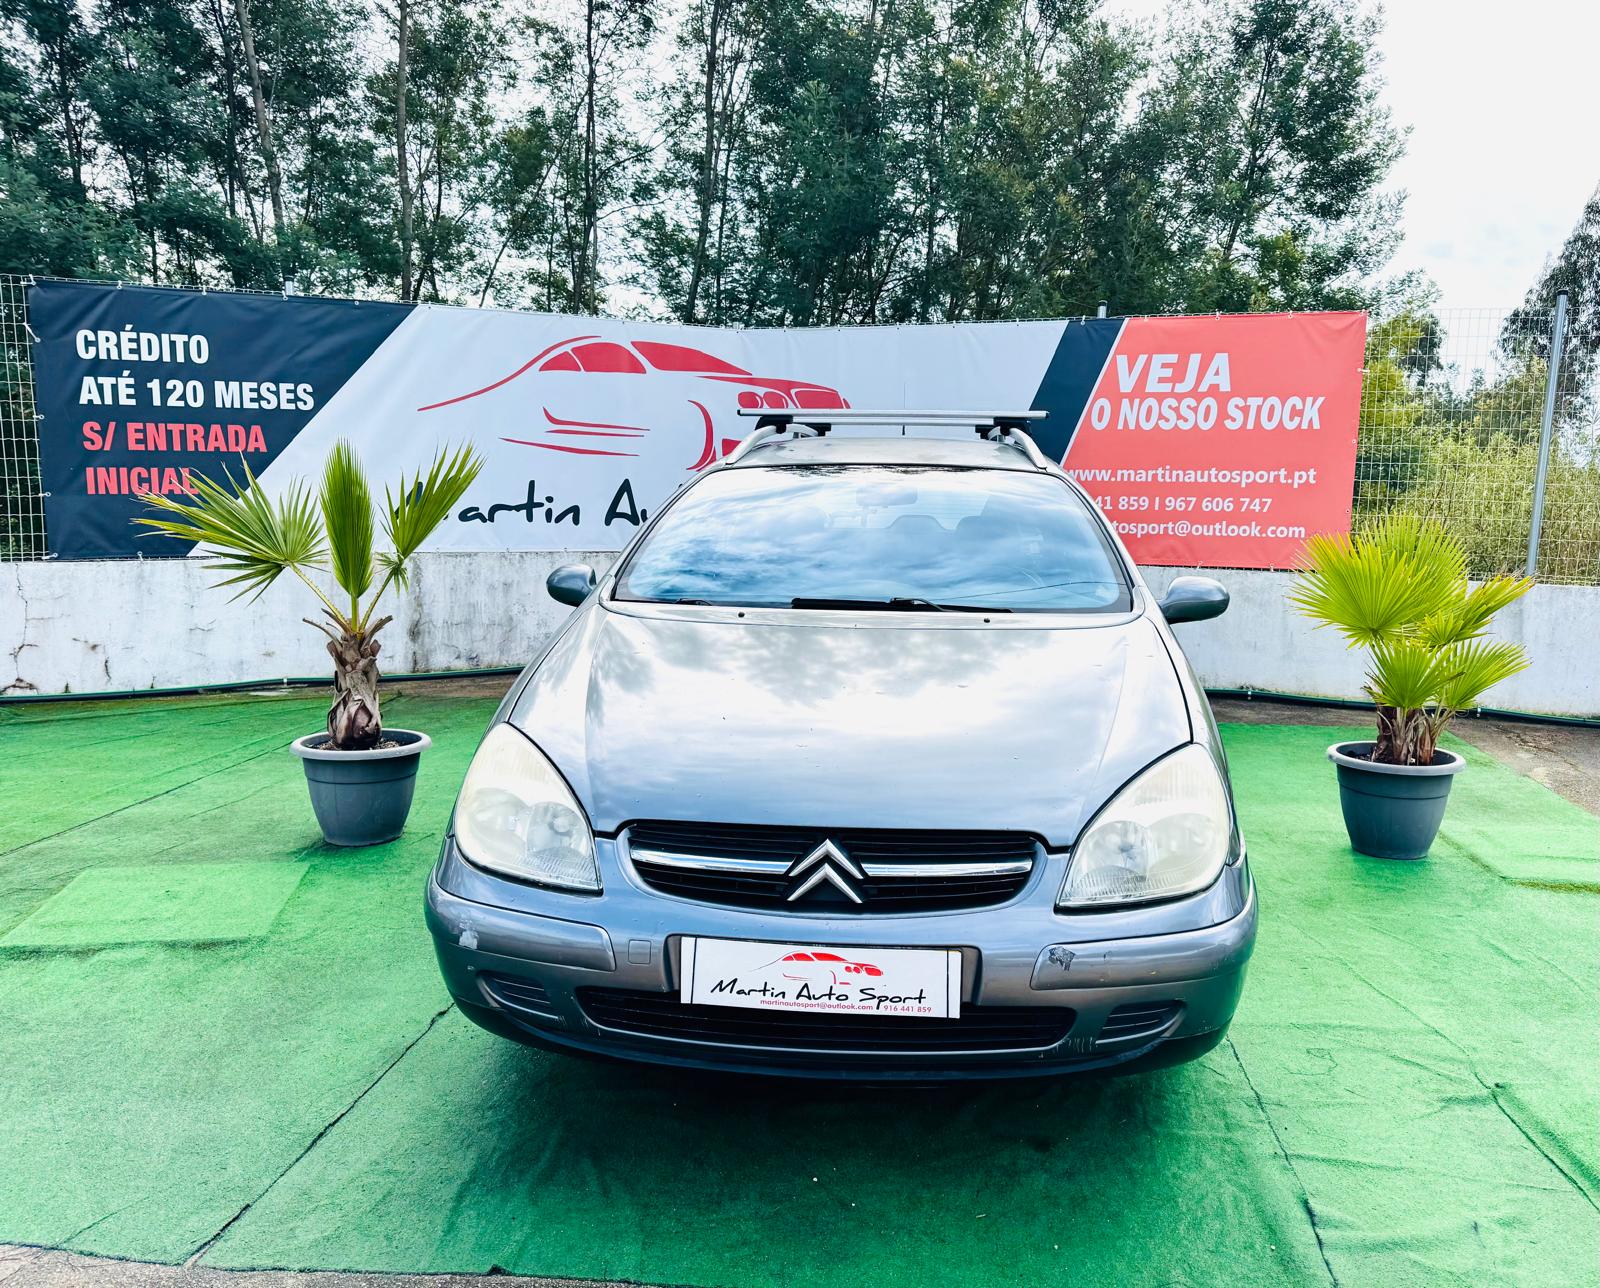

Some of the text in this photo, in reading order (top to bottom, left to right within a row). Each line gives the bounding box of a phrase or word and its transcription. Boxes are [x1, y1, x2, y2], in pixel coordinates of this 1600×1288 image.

[75, 324, 209, 364] CRÉDITO
[1115, 352, 1231, 393] VEJA
[79, 370, 315, 411] ATÉ 120 MESES
[1091, 396, 1326, 431] O NOSSO STOCK
[82, 421, 268, 453] S/ ENTRADA
[85, 466, 200, 495] INICIAL
[1118, 496, 1149, 511] 859
[1164, 496, 1196, 512] 967
[1201, 497, 1234, 512] 606
[1239, 498, 1273, 513] 747
[710, 978, 926, 1010] Martin Auto Sport
